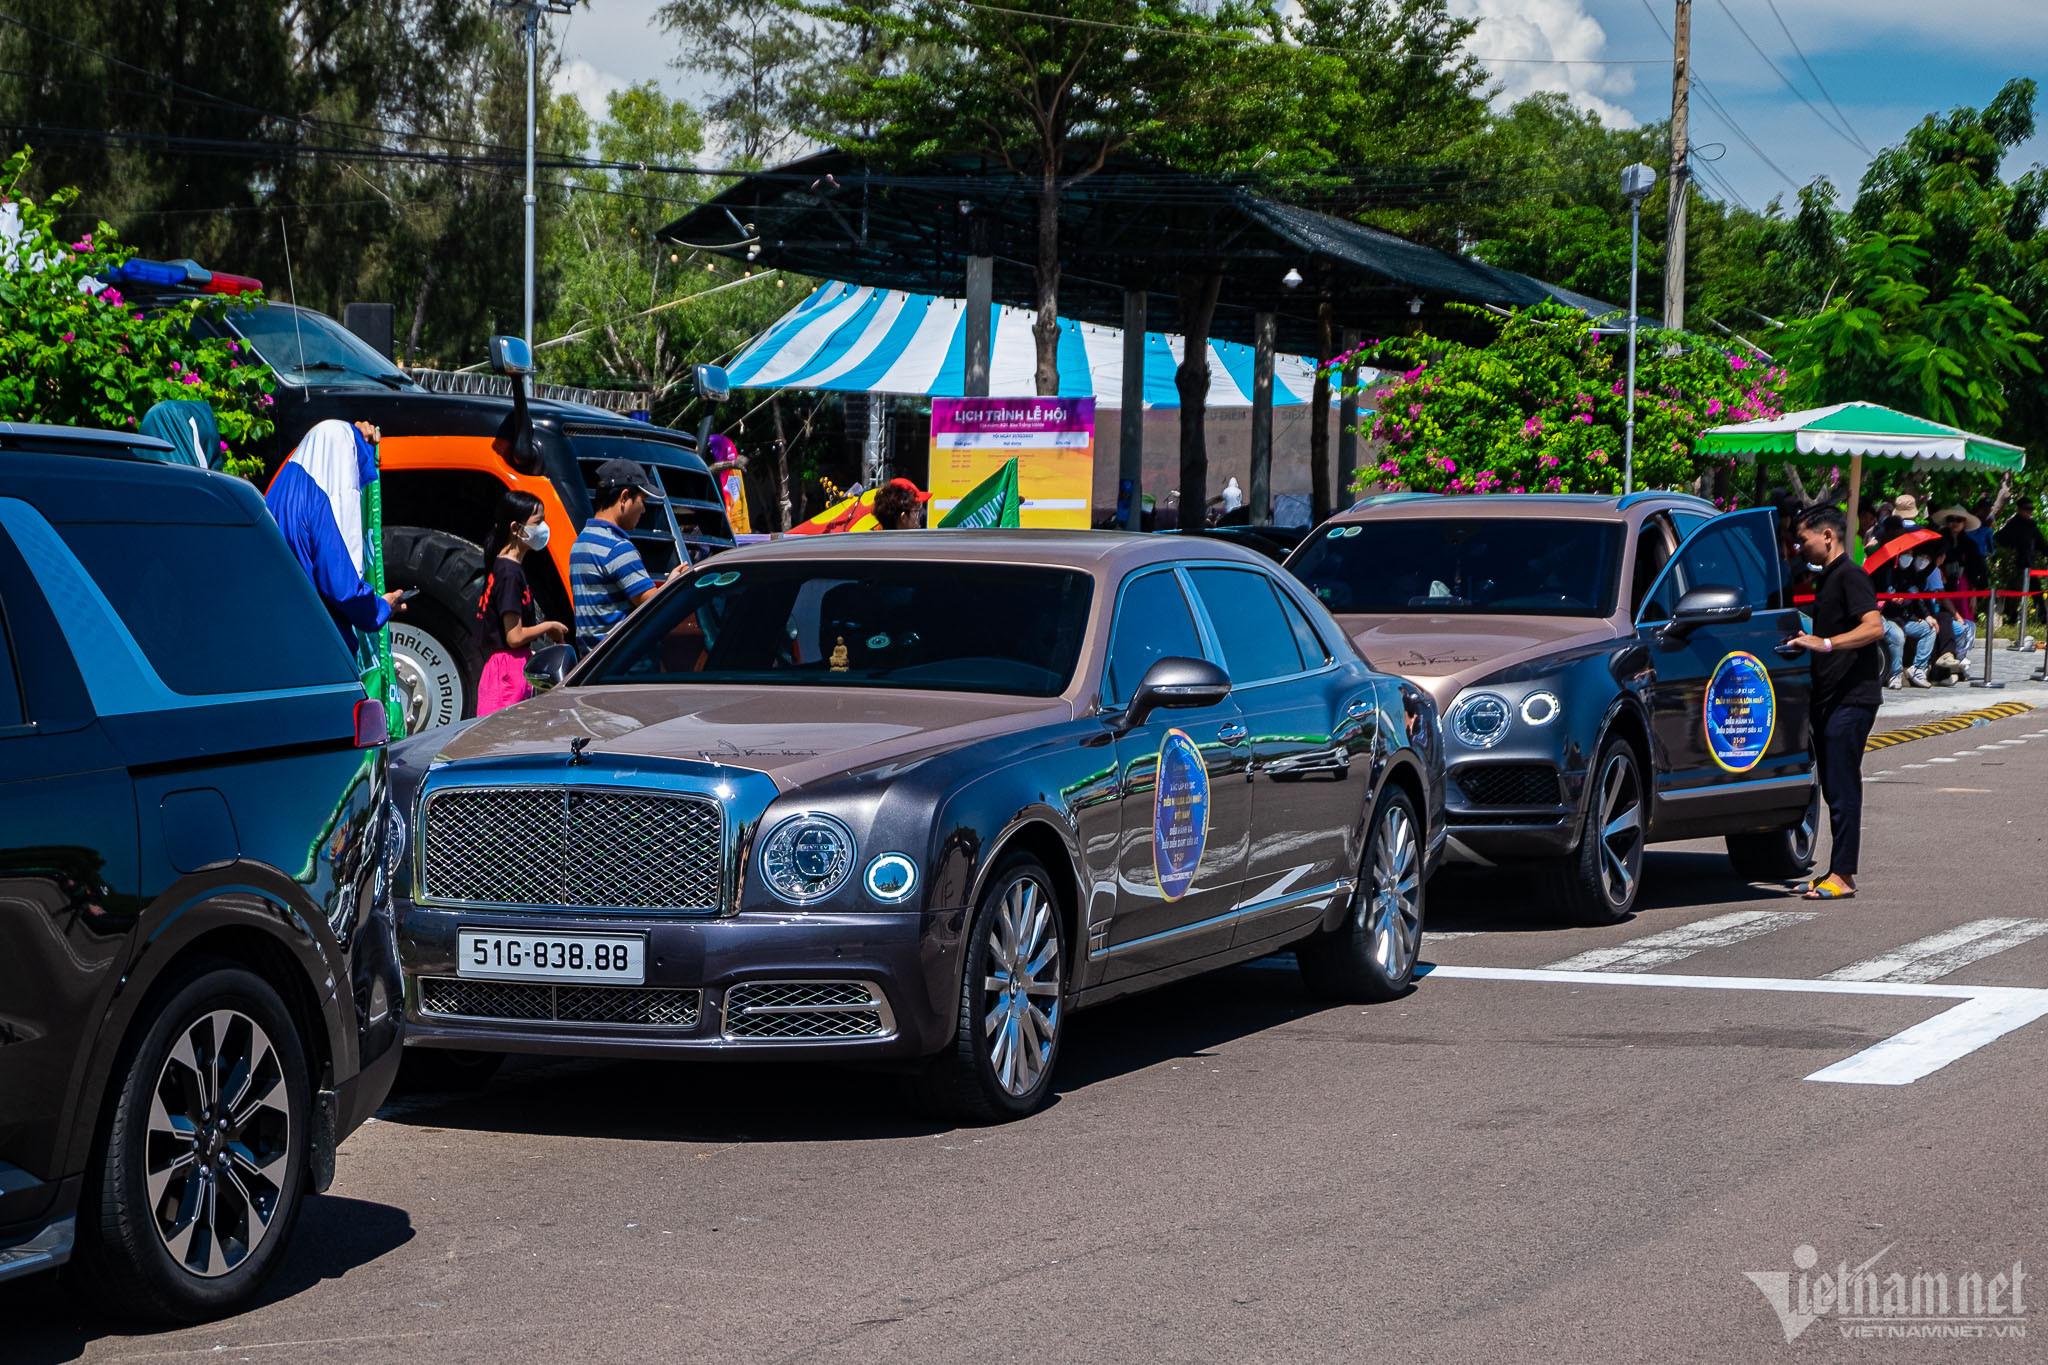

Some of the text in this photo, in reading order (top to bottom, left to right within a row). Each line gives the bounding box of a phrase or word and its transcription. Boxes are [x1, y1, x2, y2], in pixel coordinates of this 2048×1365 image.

[955, 405, 1067, 424] LỊCH TRÌNH LỄ HỘI
[473, 938, 629, 972] 51G-838.88
